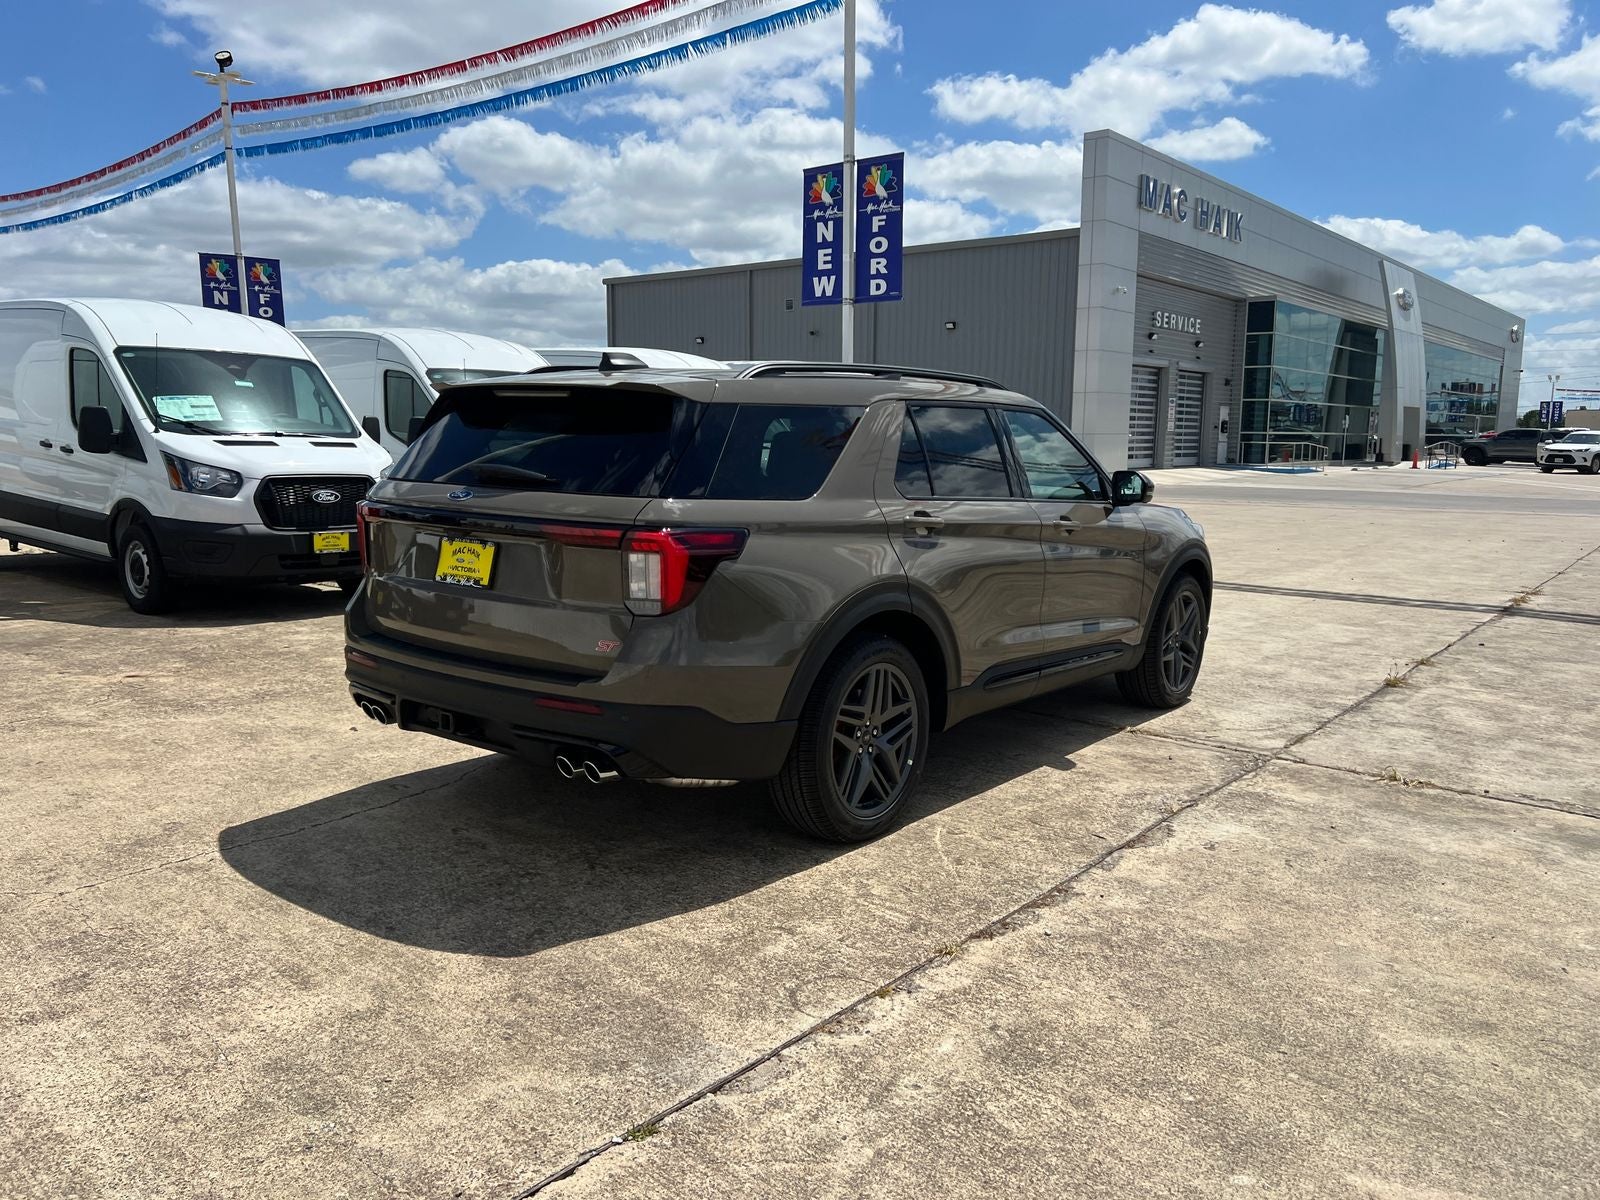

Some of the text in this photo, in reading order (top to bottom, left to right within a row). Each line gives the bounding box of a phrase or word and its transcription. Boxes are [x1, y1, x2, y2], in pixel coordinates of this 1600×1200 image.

[1140, 174, 1244, 243] MAC HAIK
[813, 220, 836, 298] NEW
[869, 215, 889, 296] FORD
[258, 293, 273, 318] FO
[1155, 311, 1202, 333] SERVICE
[318, 492, 336, 501] Ford
[452, 546, 466, 556] MAC
[595, 640, 621, 652] ST
